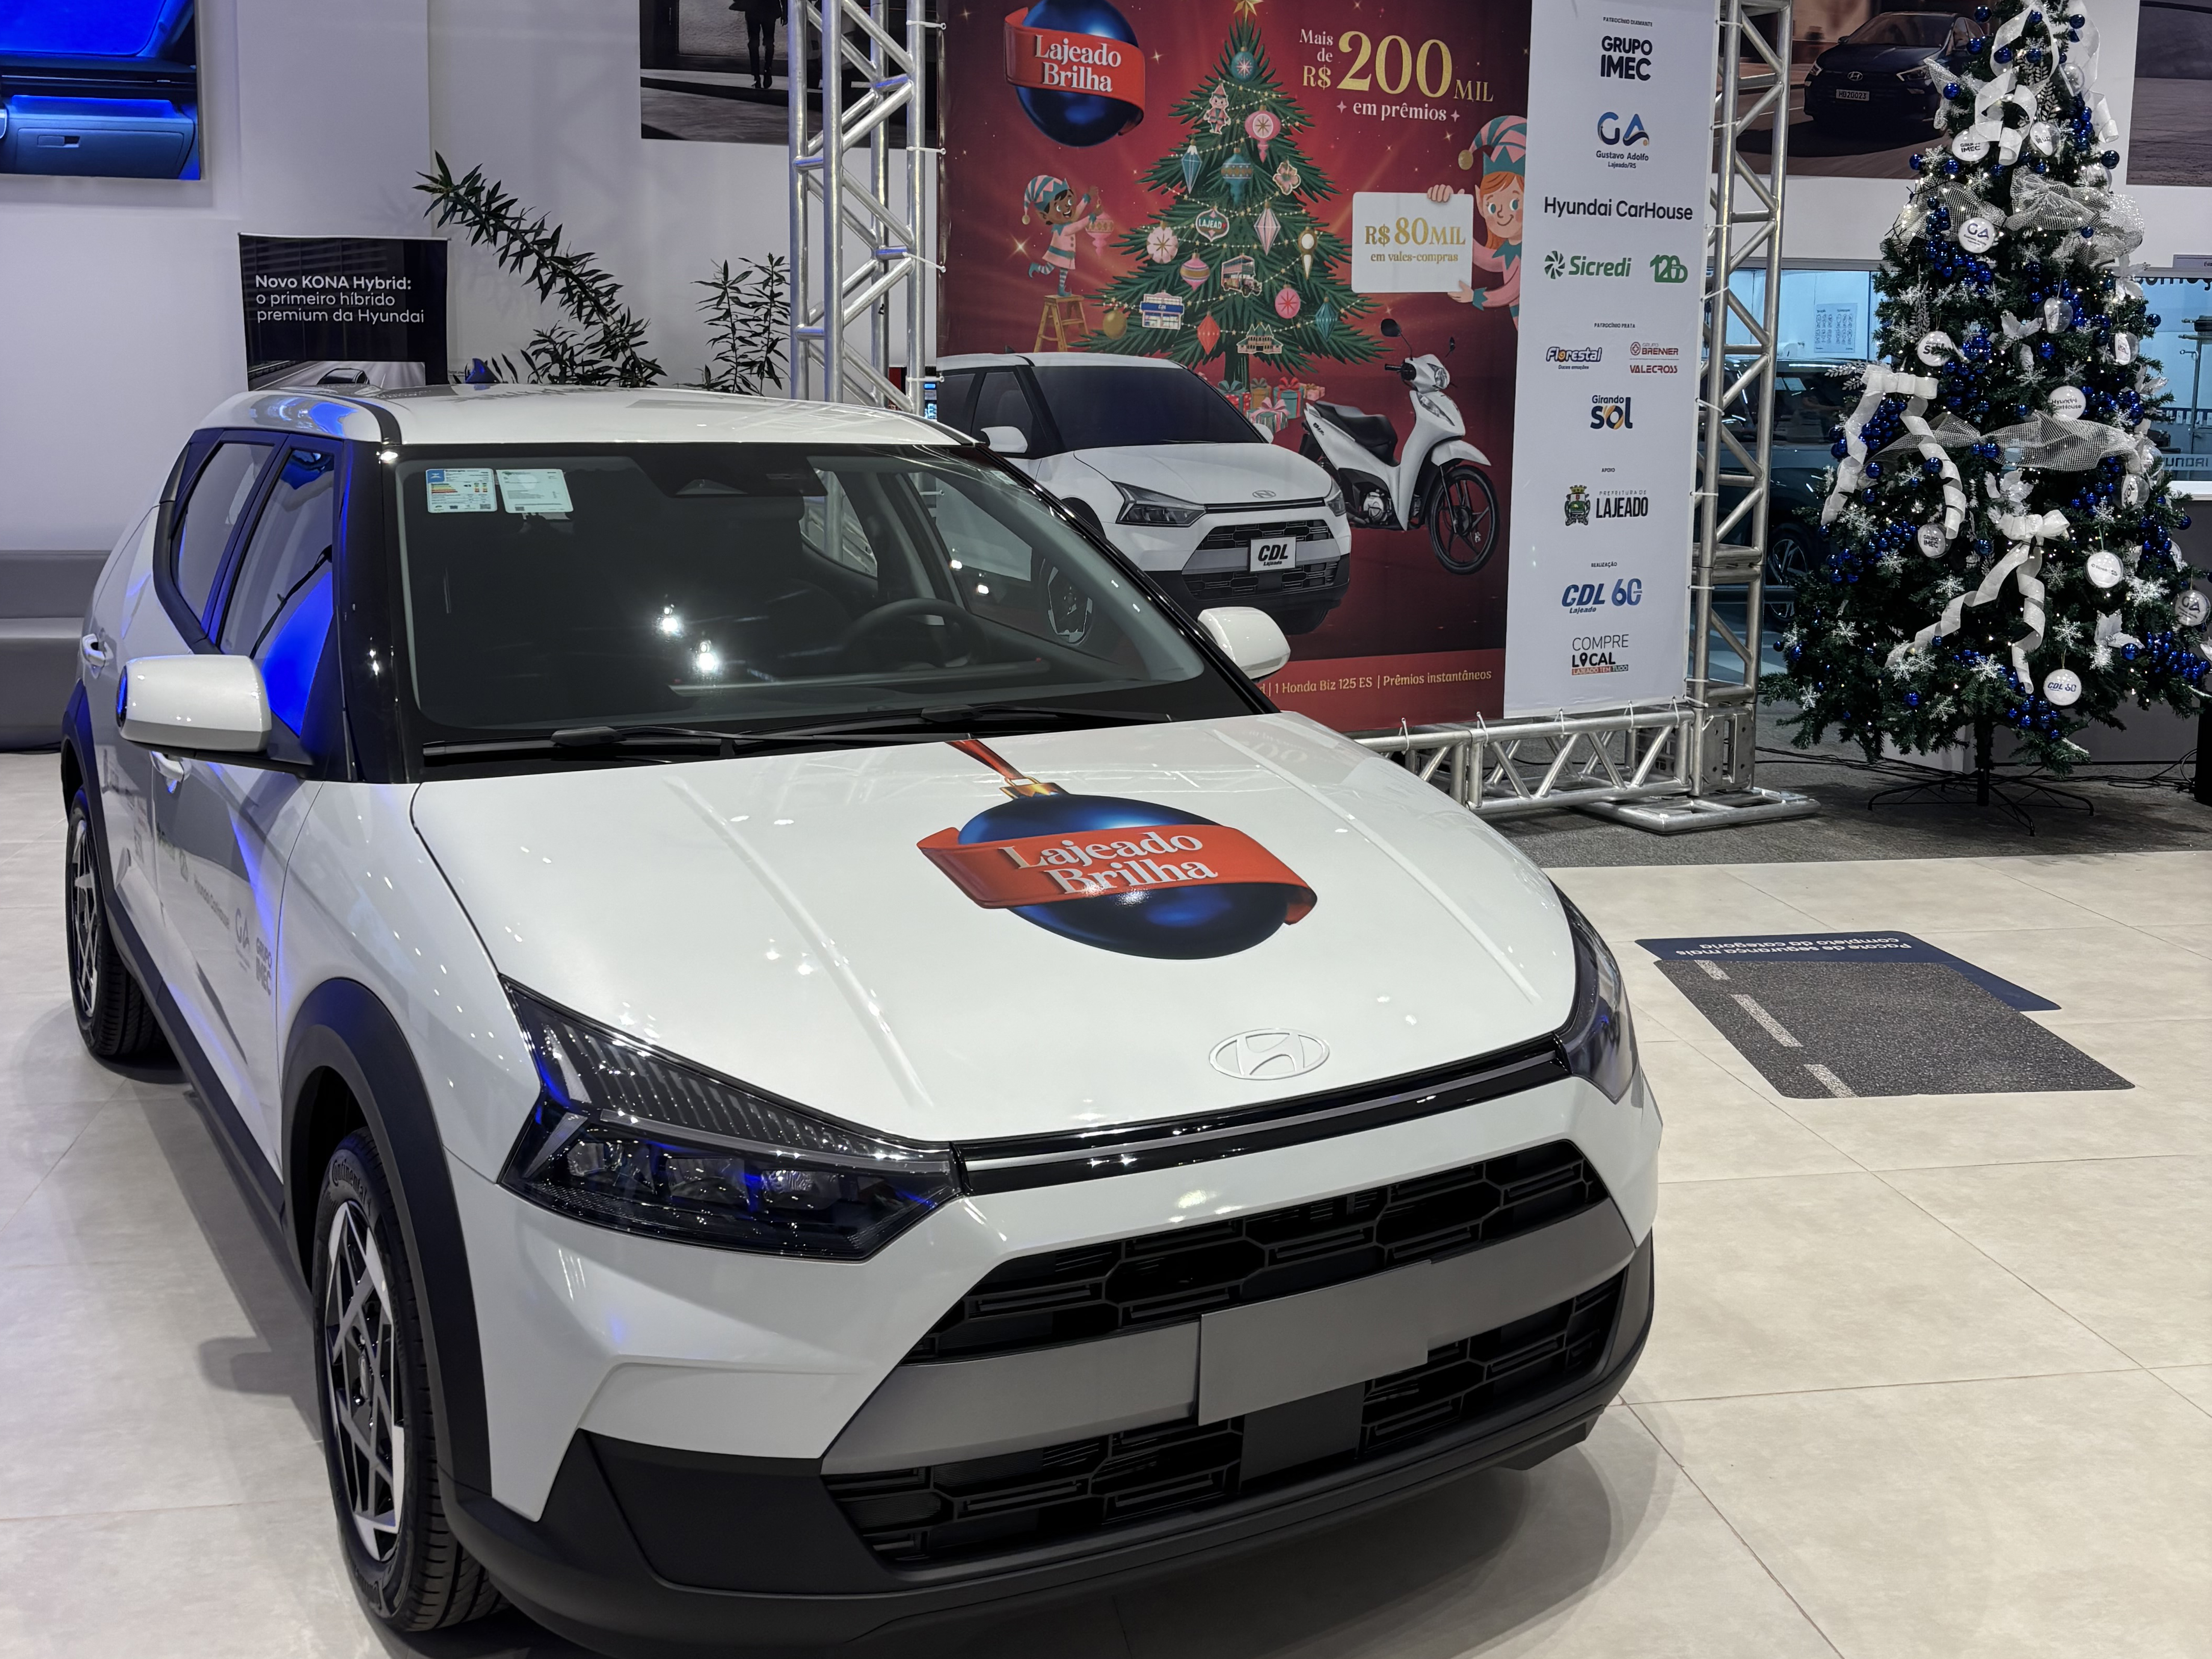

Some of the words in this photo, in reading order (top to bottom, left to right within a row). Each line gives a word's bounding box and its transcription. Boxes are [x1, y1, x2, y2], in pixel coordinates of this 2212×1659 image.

[1299, 29, 1333, 46] Mais
[1602, 36, 1653, 55] GRUPO
[1035, 34, 1121, 70] Lajeado
[1317, 48, 1333, 62] de
[1302, 65, 1331, 89] R$
[1337, 31, 1452, 98] 200
[1454, 79, 1494, 102] MIL
[1601, 54, 1652, 81] IMEC
[1042, 62, 1113, 93] Brilha
[1353, 101, 1377, 116] em
[1381, 102, 1447, 121] prêmios
[1596, 150, 1625, 159] Gustavo
[1627, 152, 1649, 161] Adolfo
[1544, 196, 1613, 217] Hyundai
[1616, 200, 1693, 220] CarHouse
[1364, 223, 1390, 247] R$
[1388, 251, 1458, 264] vales-compras
[1568, 255, 1632, 278] Sicredi
[256, 275, 297, 288] Novo
[302, 276, 349, 289] KONA
[354, 276, 411, 292] Hybrid:
[256, 294, 266, 304] o
[271, 291, 336, 307] primeiro
[340, 292, 395, 306] híbrido
[258, 309, 328, 323] premium
[333, 309, 353, 322] da
[358, 310, 424, 325] Hyundai
[1546, 346, 1602, 362] Florestal
[1630, 365, 1678, 373] VALECROSS
[1592, 395, 1625, 404] Girando
[2162, 457, 2208, 467] UNDAI
[1596, 496, 1648, 518] LAJEADO
[1258, 544, 1288, 562] CDL
[1562, 583, 1605, 607] CDL
[1572, 634, 1629, 651] COMPRE
[1275, 683, 1278, 694] 1
[1282, 681, 1317, 694] Honda
[1320, 680, 1336, 691] Biz
[1339, 678, 1356, 689] 125
[1359, 677, 1372, 688] ES
[1383, 675, 1424, 686] Prêmios
[1427, 670, 1492, 684] instantâneos
[999, 831, 1203, 869] Lajeado
[1043, 858, 1218, 895] Brilha
